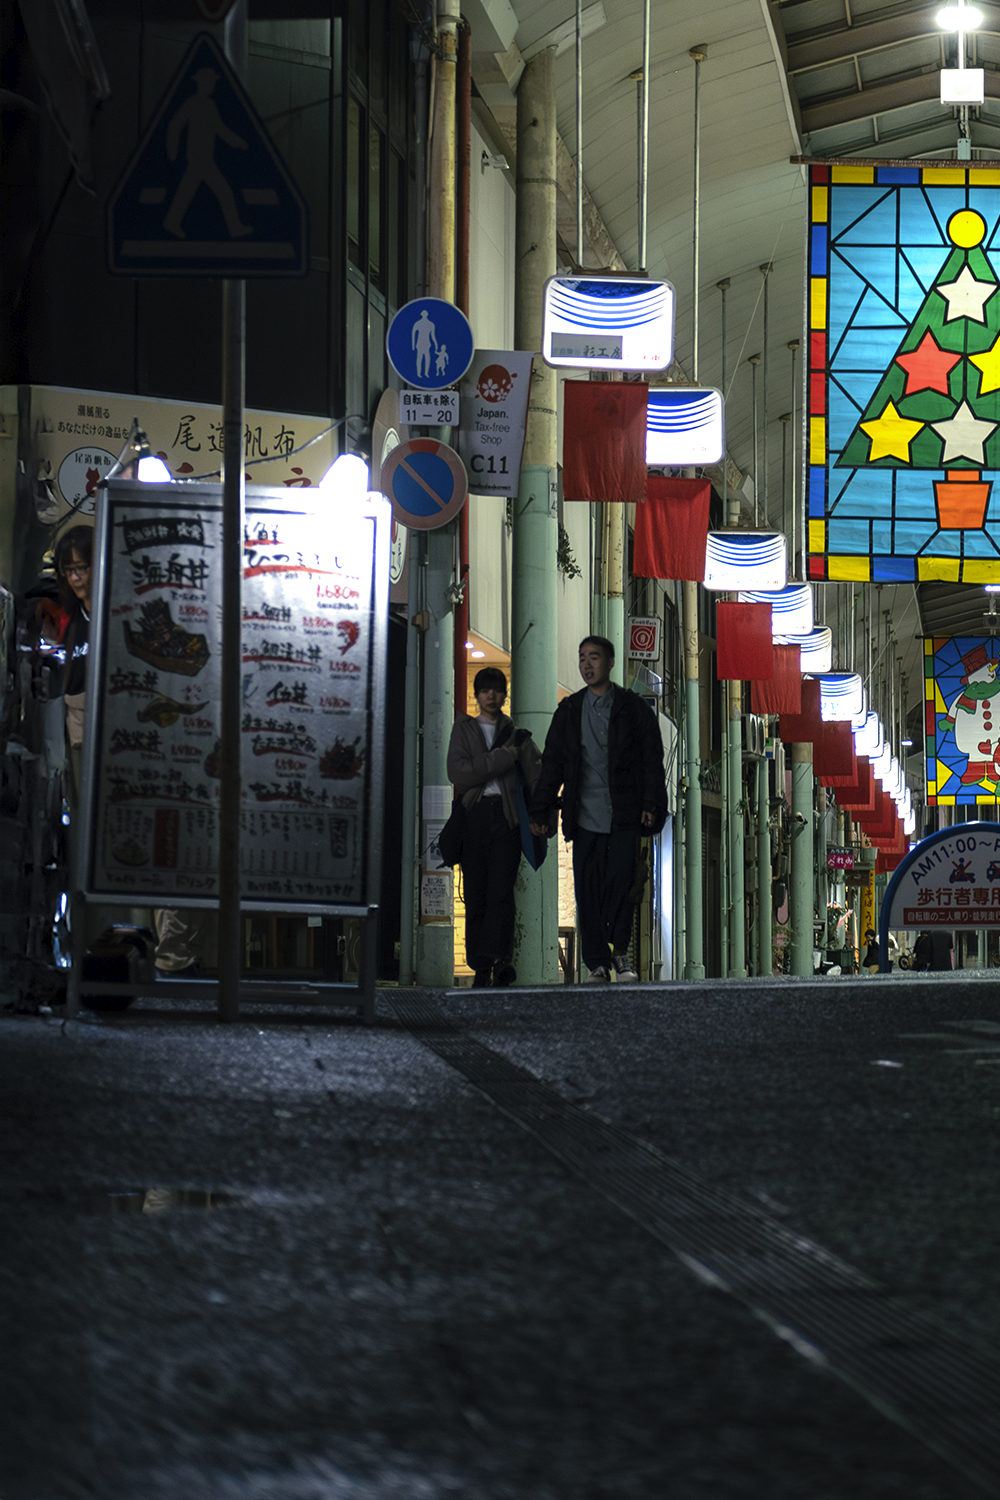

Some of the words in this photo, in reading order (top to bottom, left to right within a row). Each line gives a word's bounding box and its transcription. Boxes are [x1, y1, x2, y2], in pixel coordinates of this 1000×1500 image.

[403, 394, 456, 407] 自転車を除く
[477, 408, 509, 420] Japan.
[475, 422, 510, 433] Tax-free
[171, 415, 295, 462] 尾道帆布
[480, 434, 502, 446] Shop
[470, 455, 509, 474] C11
